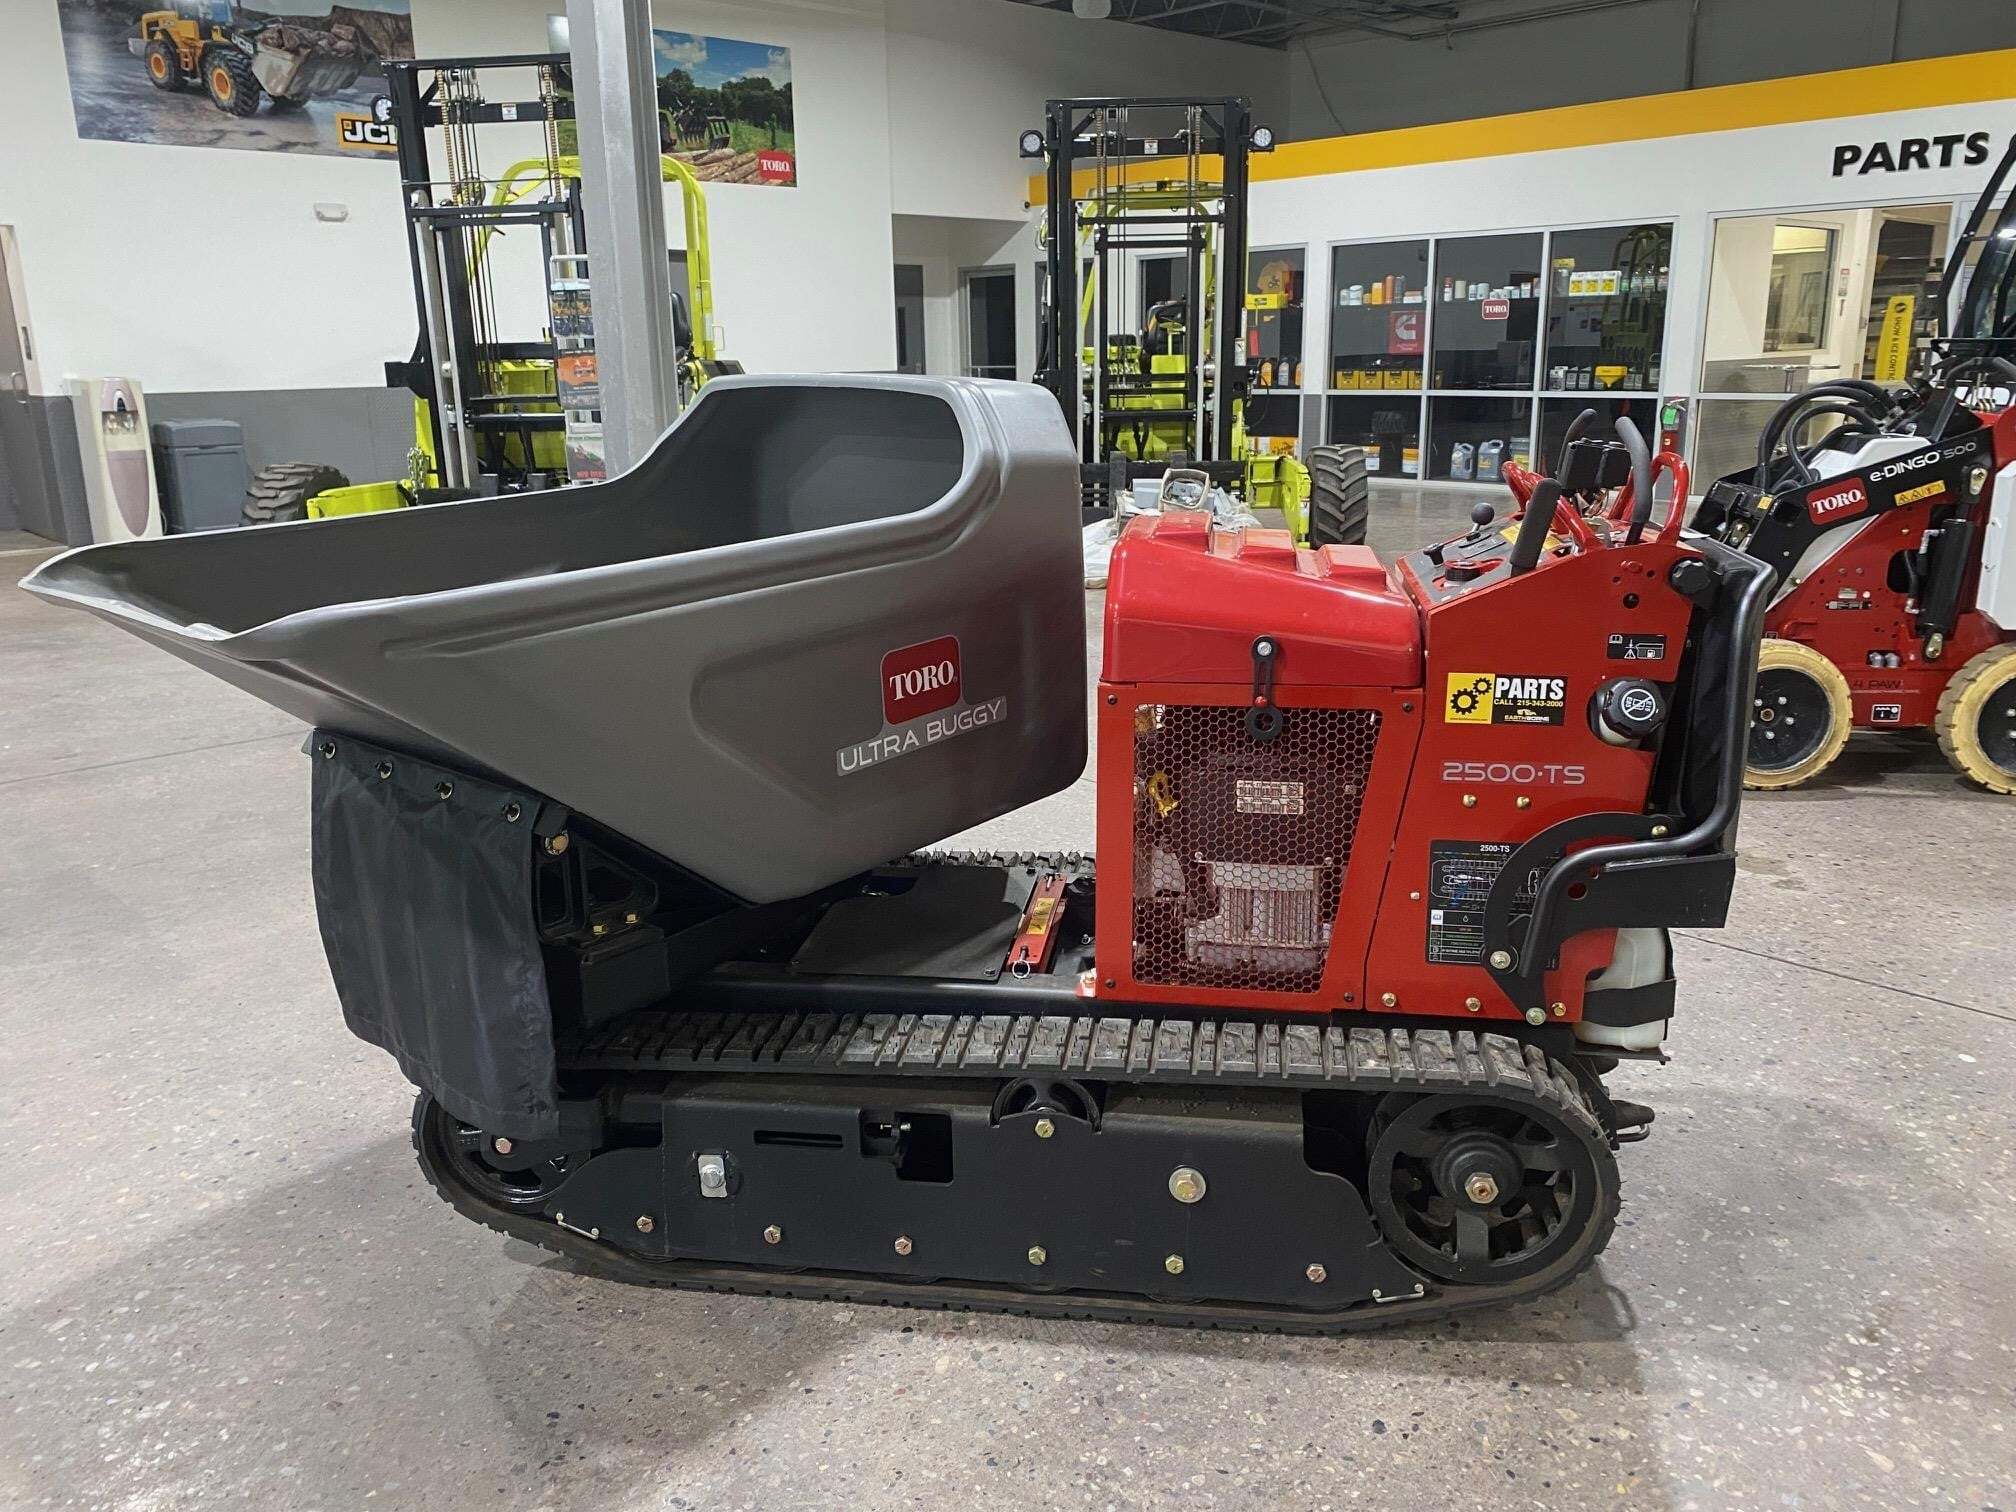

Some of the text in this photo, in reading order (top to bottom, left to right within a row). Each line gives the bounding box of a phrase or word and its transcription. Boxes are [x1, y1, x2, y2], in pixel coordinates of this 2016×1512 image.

[1832, 132, 1990, 177] PARTS
[760, 159, 791, 172] TORO
[1484, 305, 1508, 314] TORO
[1943, 442, 1977, 459] 500
[1812, 488, 1863, 515] TORO
[889, 660, 957, 701] TORO
[1495, 677, 1564, 701] PARTS
[1494, 698, 1564, 708] CALL 215-343-2000
[840, 700, 1001, 771] ULTRA BUGGY
[1480, 844, 1510, 853] 2500-TS
